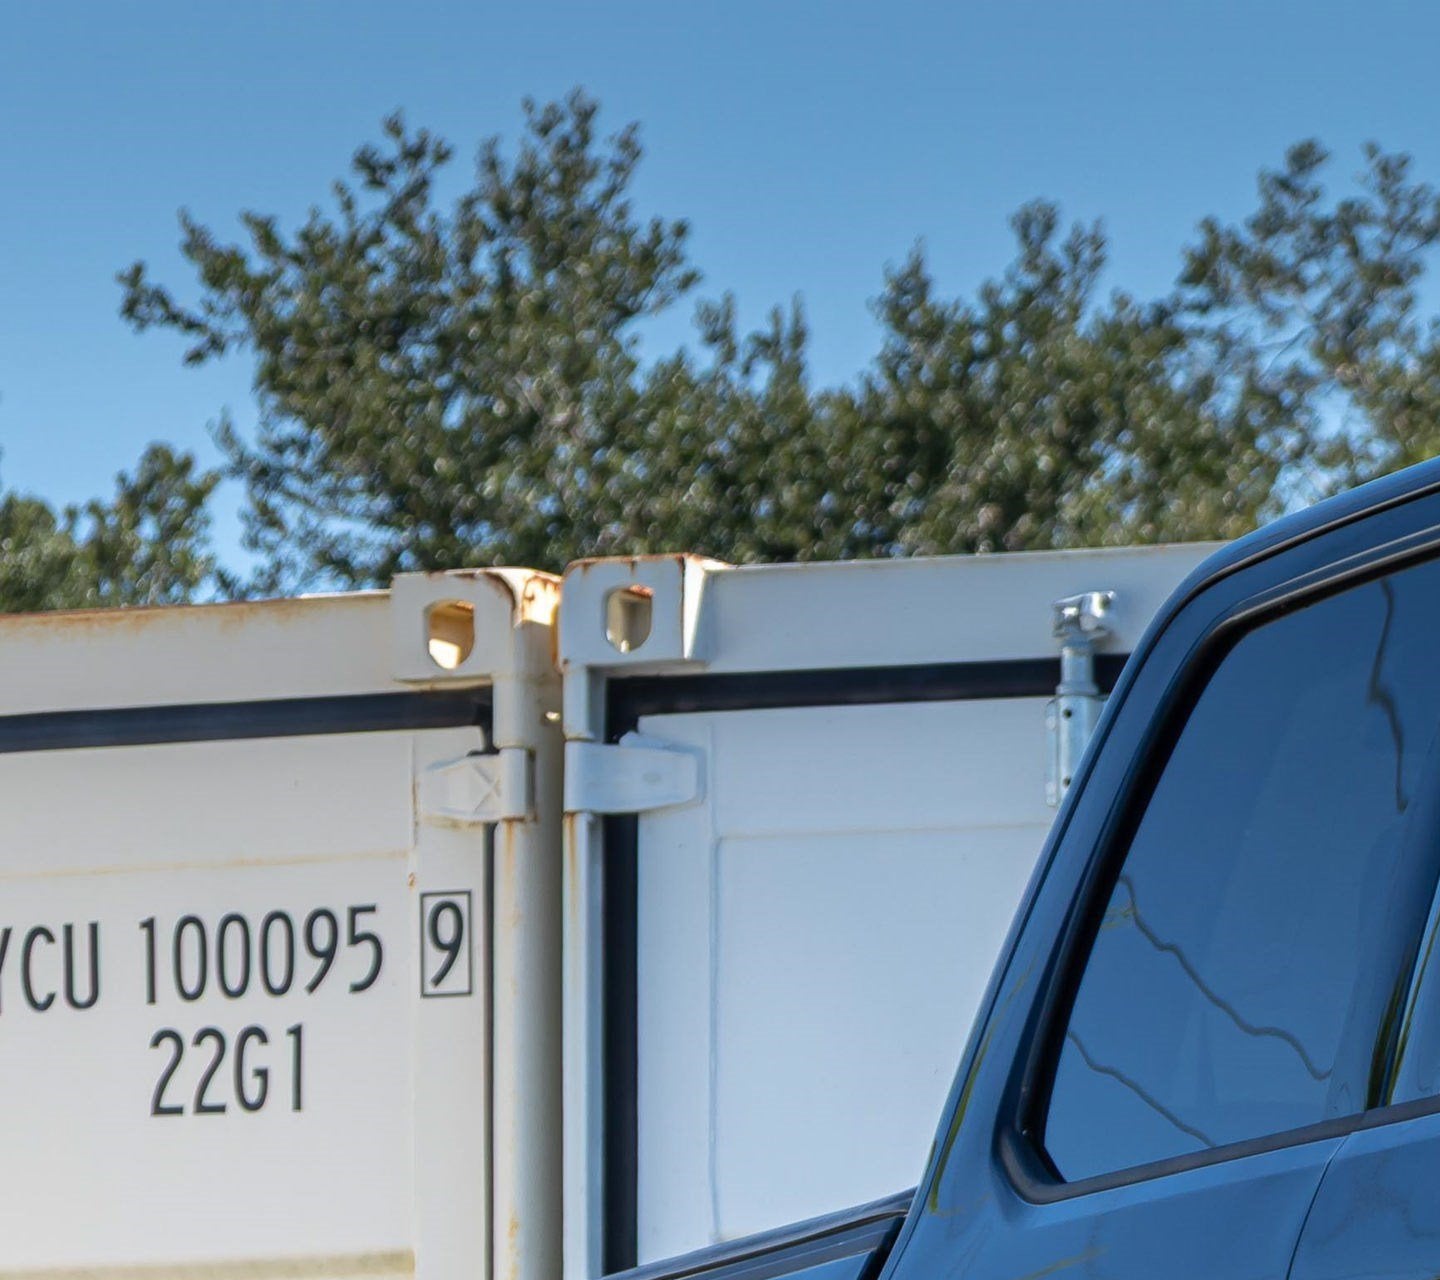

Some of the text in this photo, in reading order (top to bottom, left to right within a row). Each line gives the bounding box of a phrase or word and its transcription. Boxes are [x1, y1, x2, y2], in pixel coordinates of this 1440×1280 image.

[139, 904, 384, 1005] 100095
[427, 901, 464, 988] 9
[149, 1022, 305, 1118] 22G1
